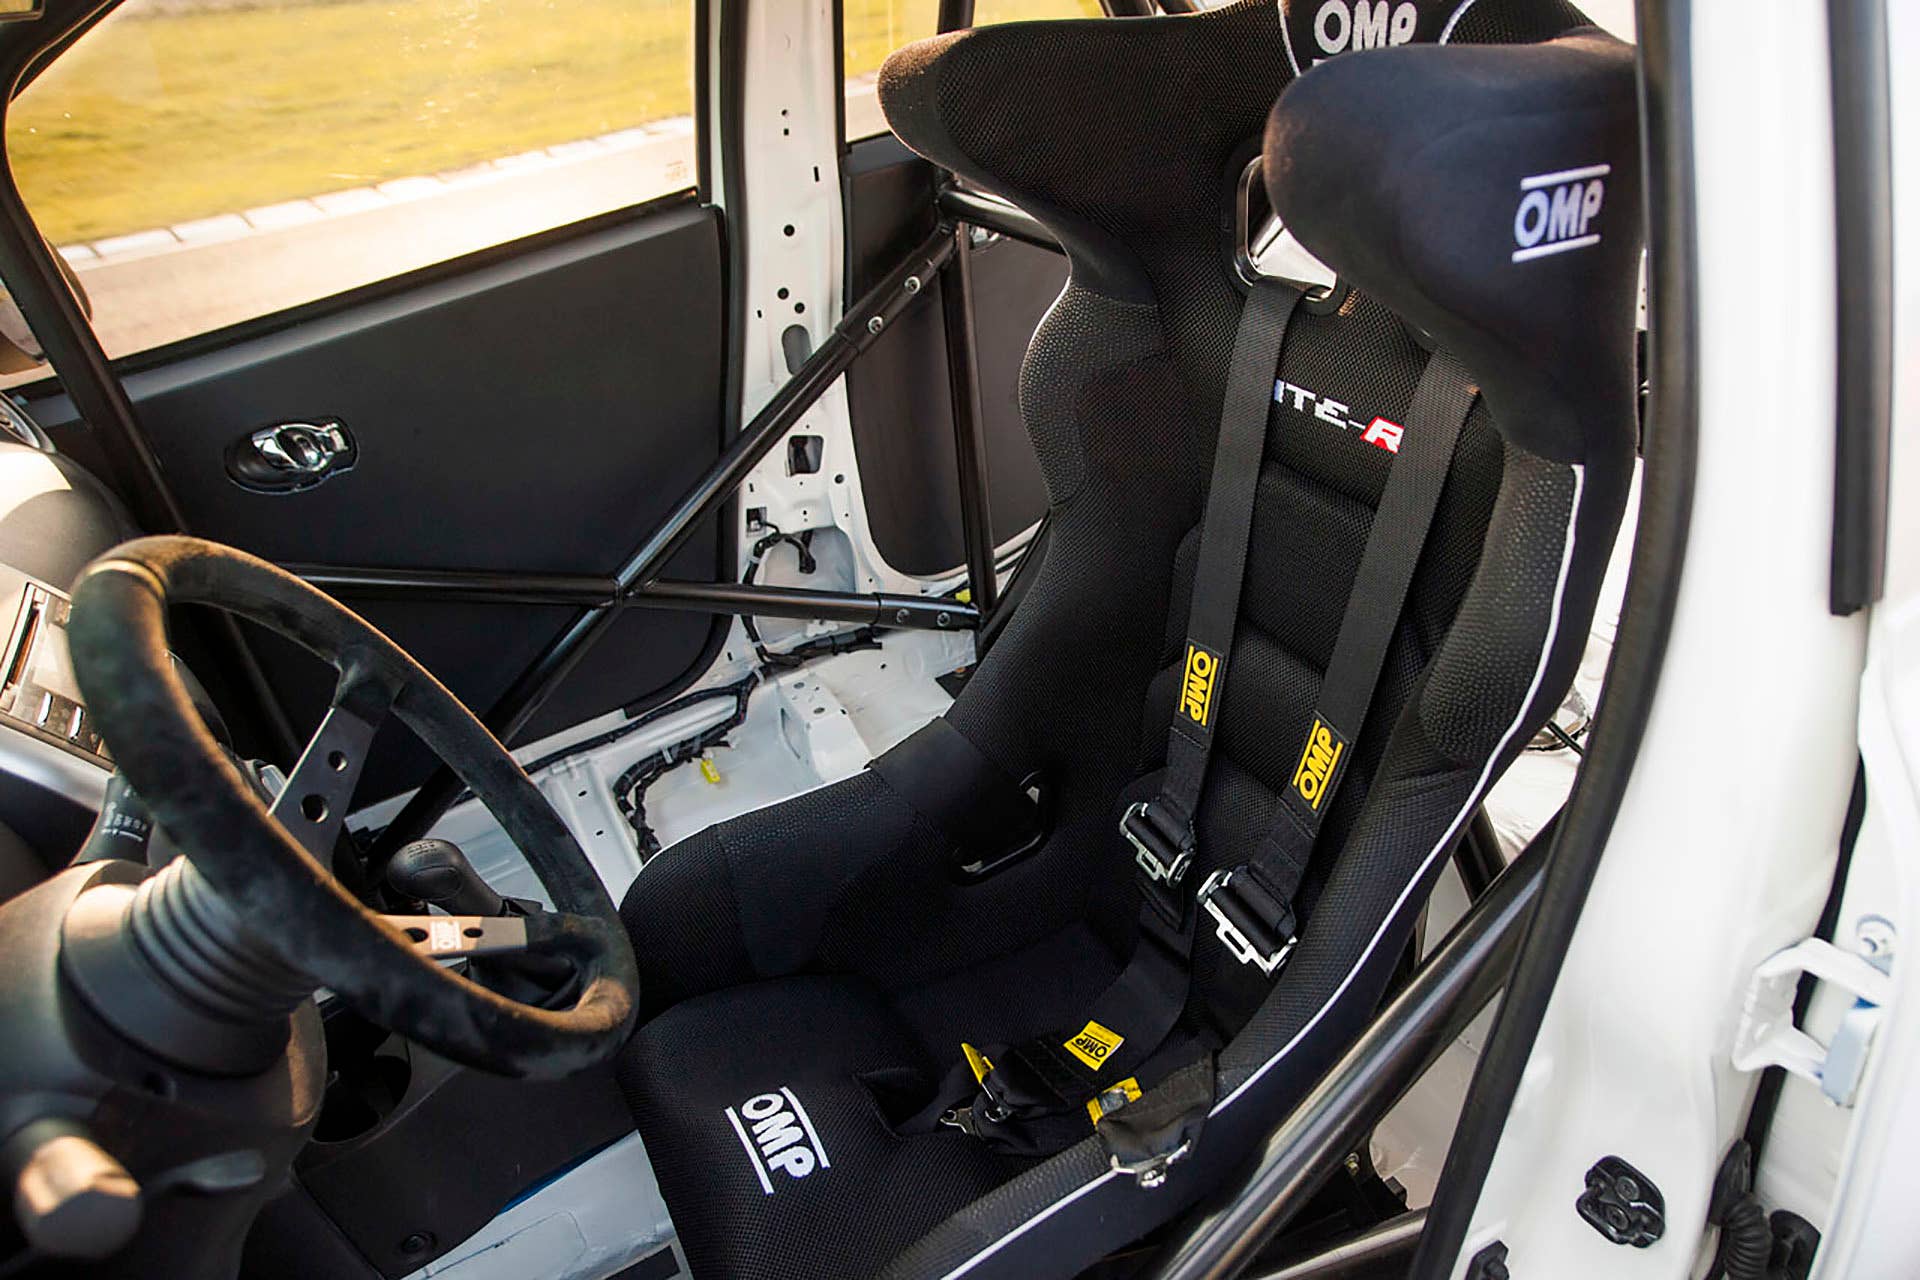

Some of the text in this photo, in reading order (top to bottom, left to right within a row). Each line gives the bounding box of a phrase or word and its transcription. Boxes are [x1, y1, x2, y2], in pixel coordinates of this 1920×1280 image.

[1314, 0, 1417, 54] OMP
[1514, 179, 1604, 248] OMP
[1186, 651, 1211, 721] OMP
[1299, 727, 1334, 800] OMP
[1075, 1037, 1108, 1058] OMP
[741, 1093, 816, 1178] OMP
